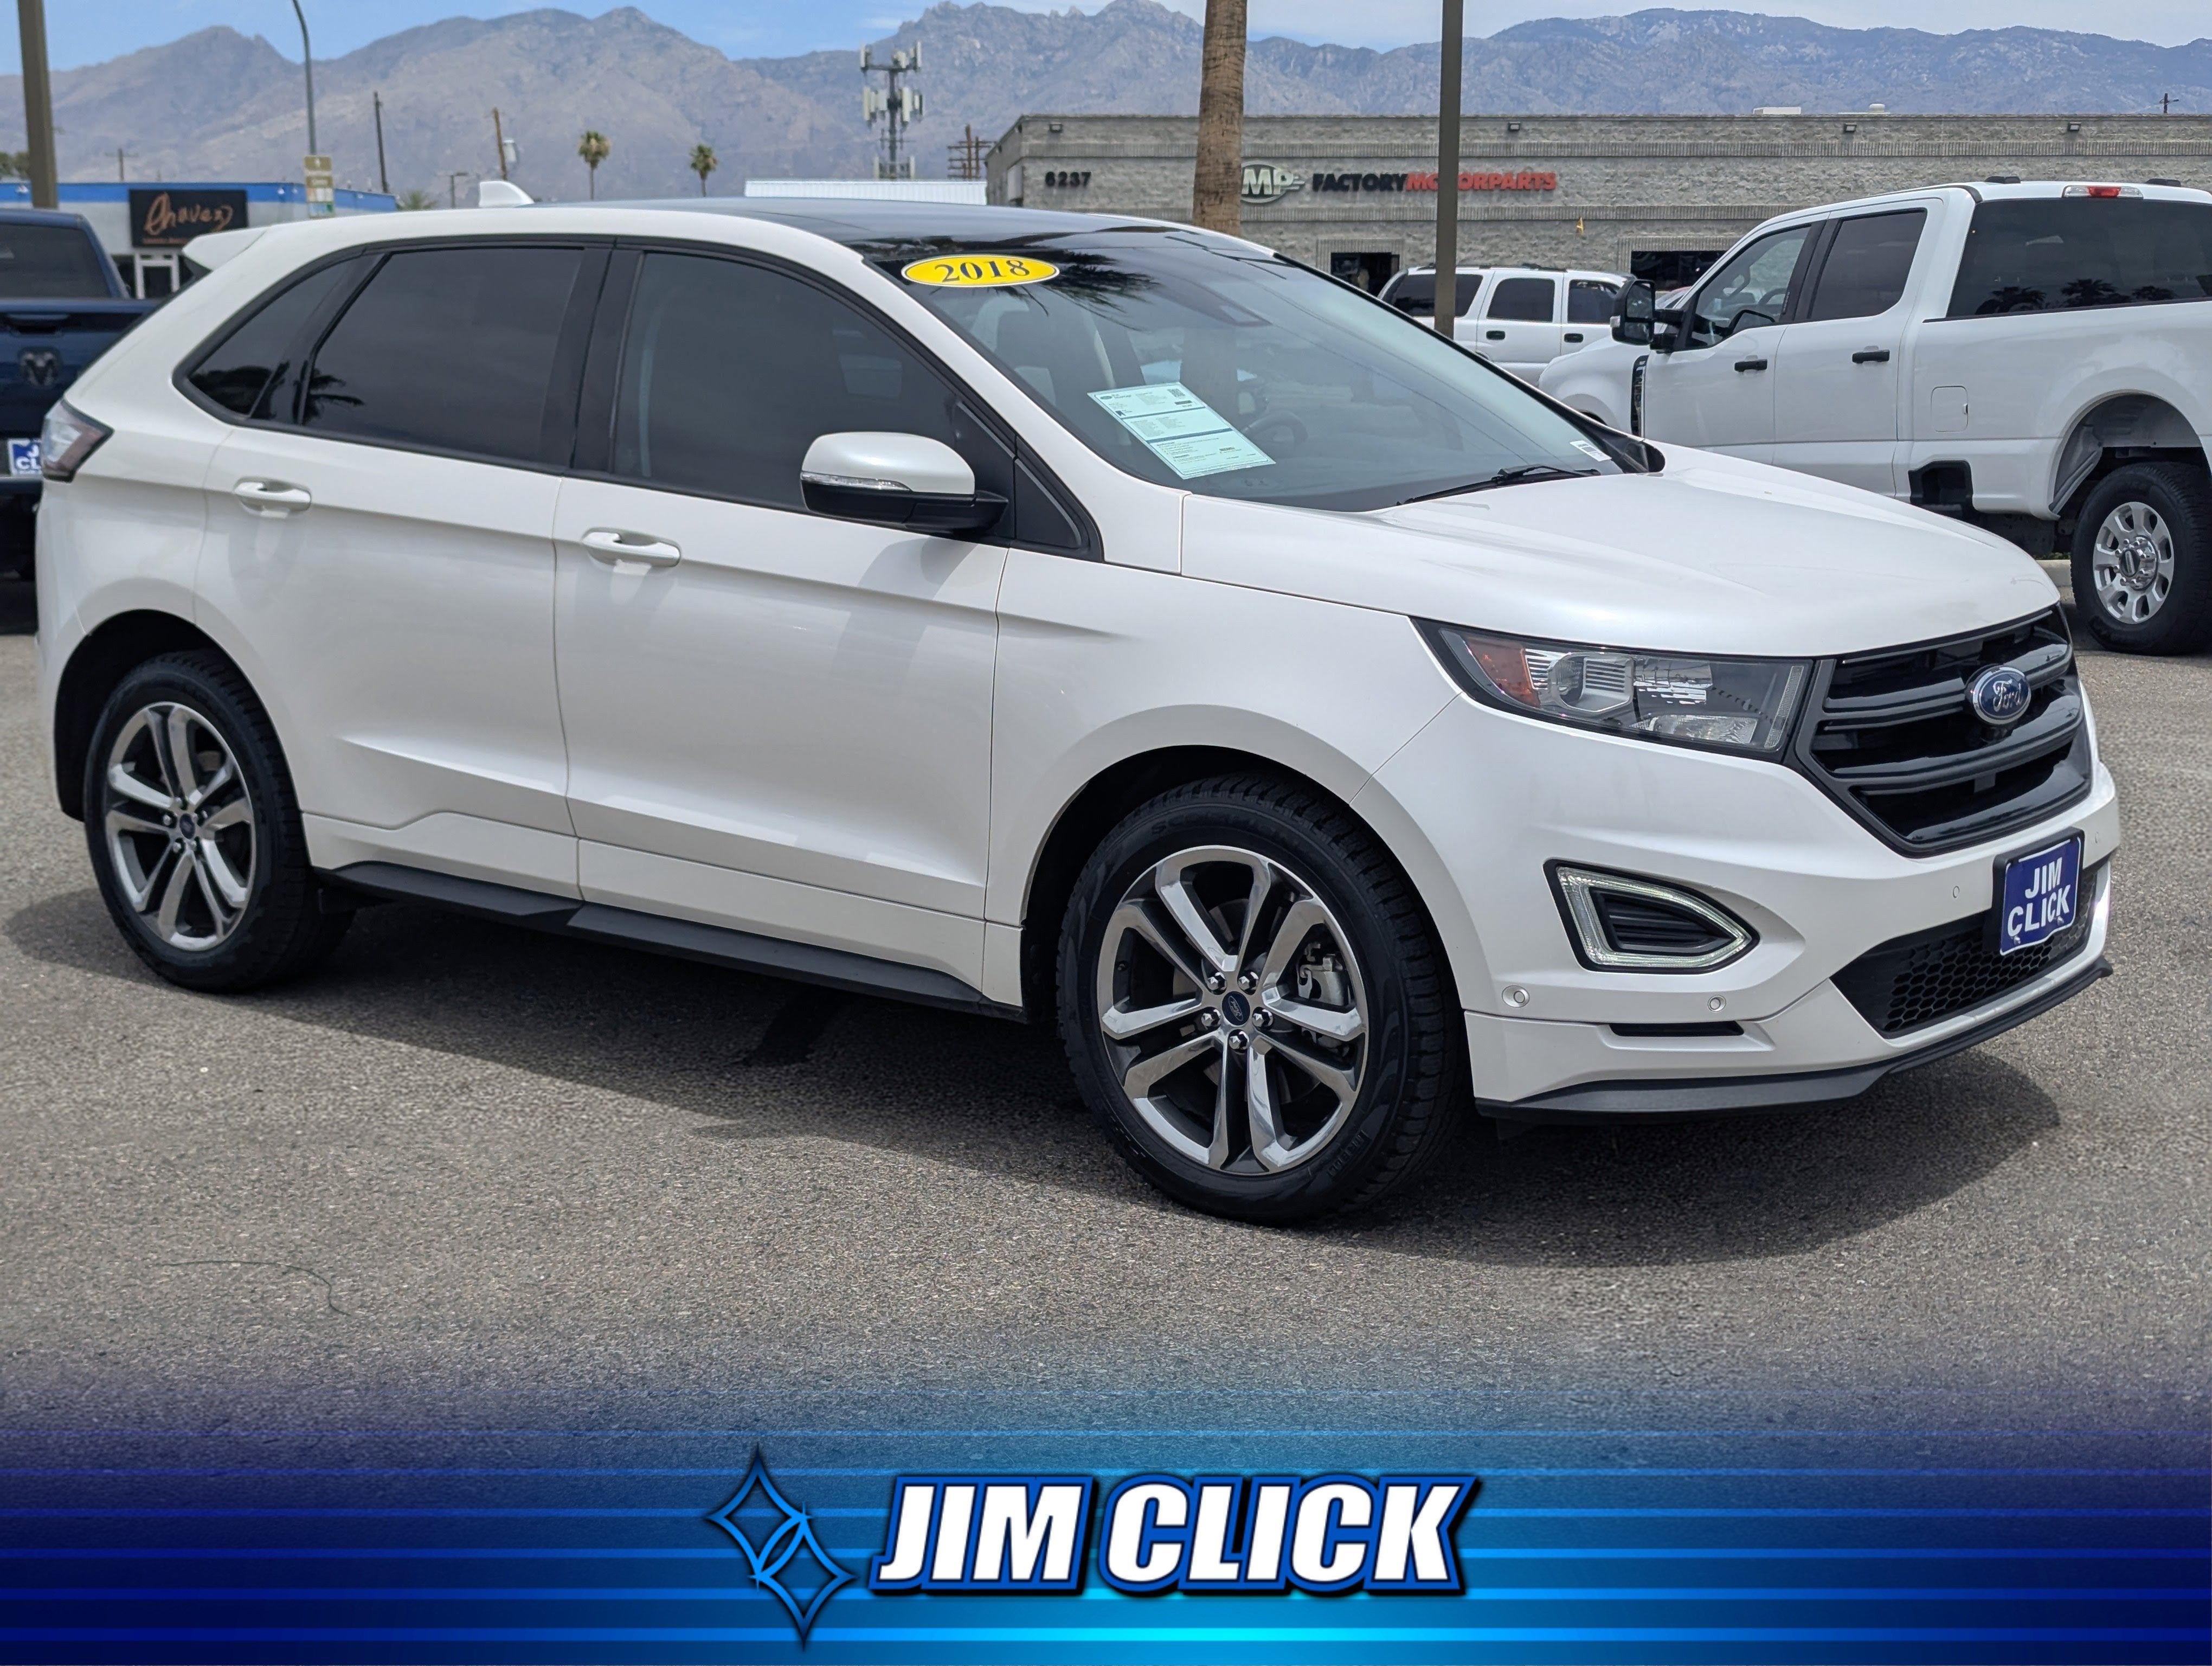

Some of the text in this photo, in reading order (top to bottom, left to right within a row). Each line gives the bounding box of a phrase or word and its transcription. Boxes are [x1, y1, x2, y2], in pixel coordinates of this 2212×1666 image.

[1241, 168, 1294, 195] MP
[934, 260, 1030, 283] 2018
[1993, 679, 2023, 712] Ford
[2025, 857, 2062, 899] JIM
[2008, 885, 2070, 937] CLICK
